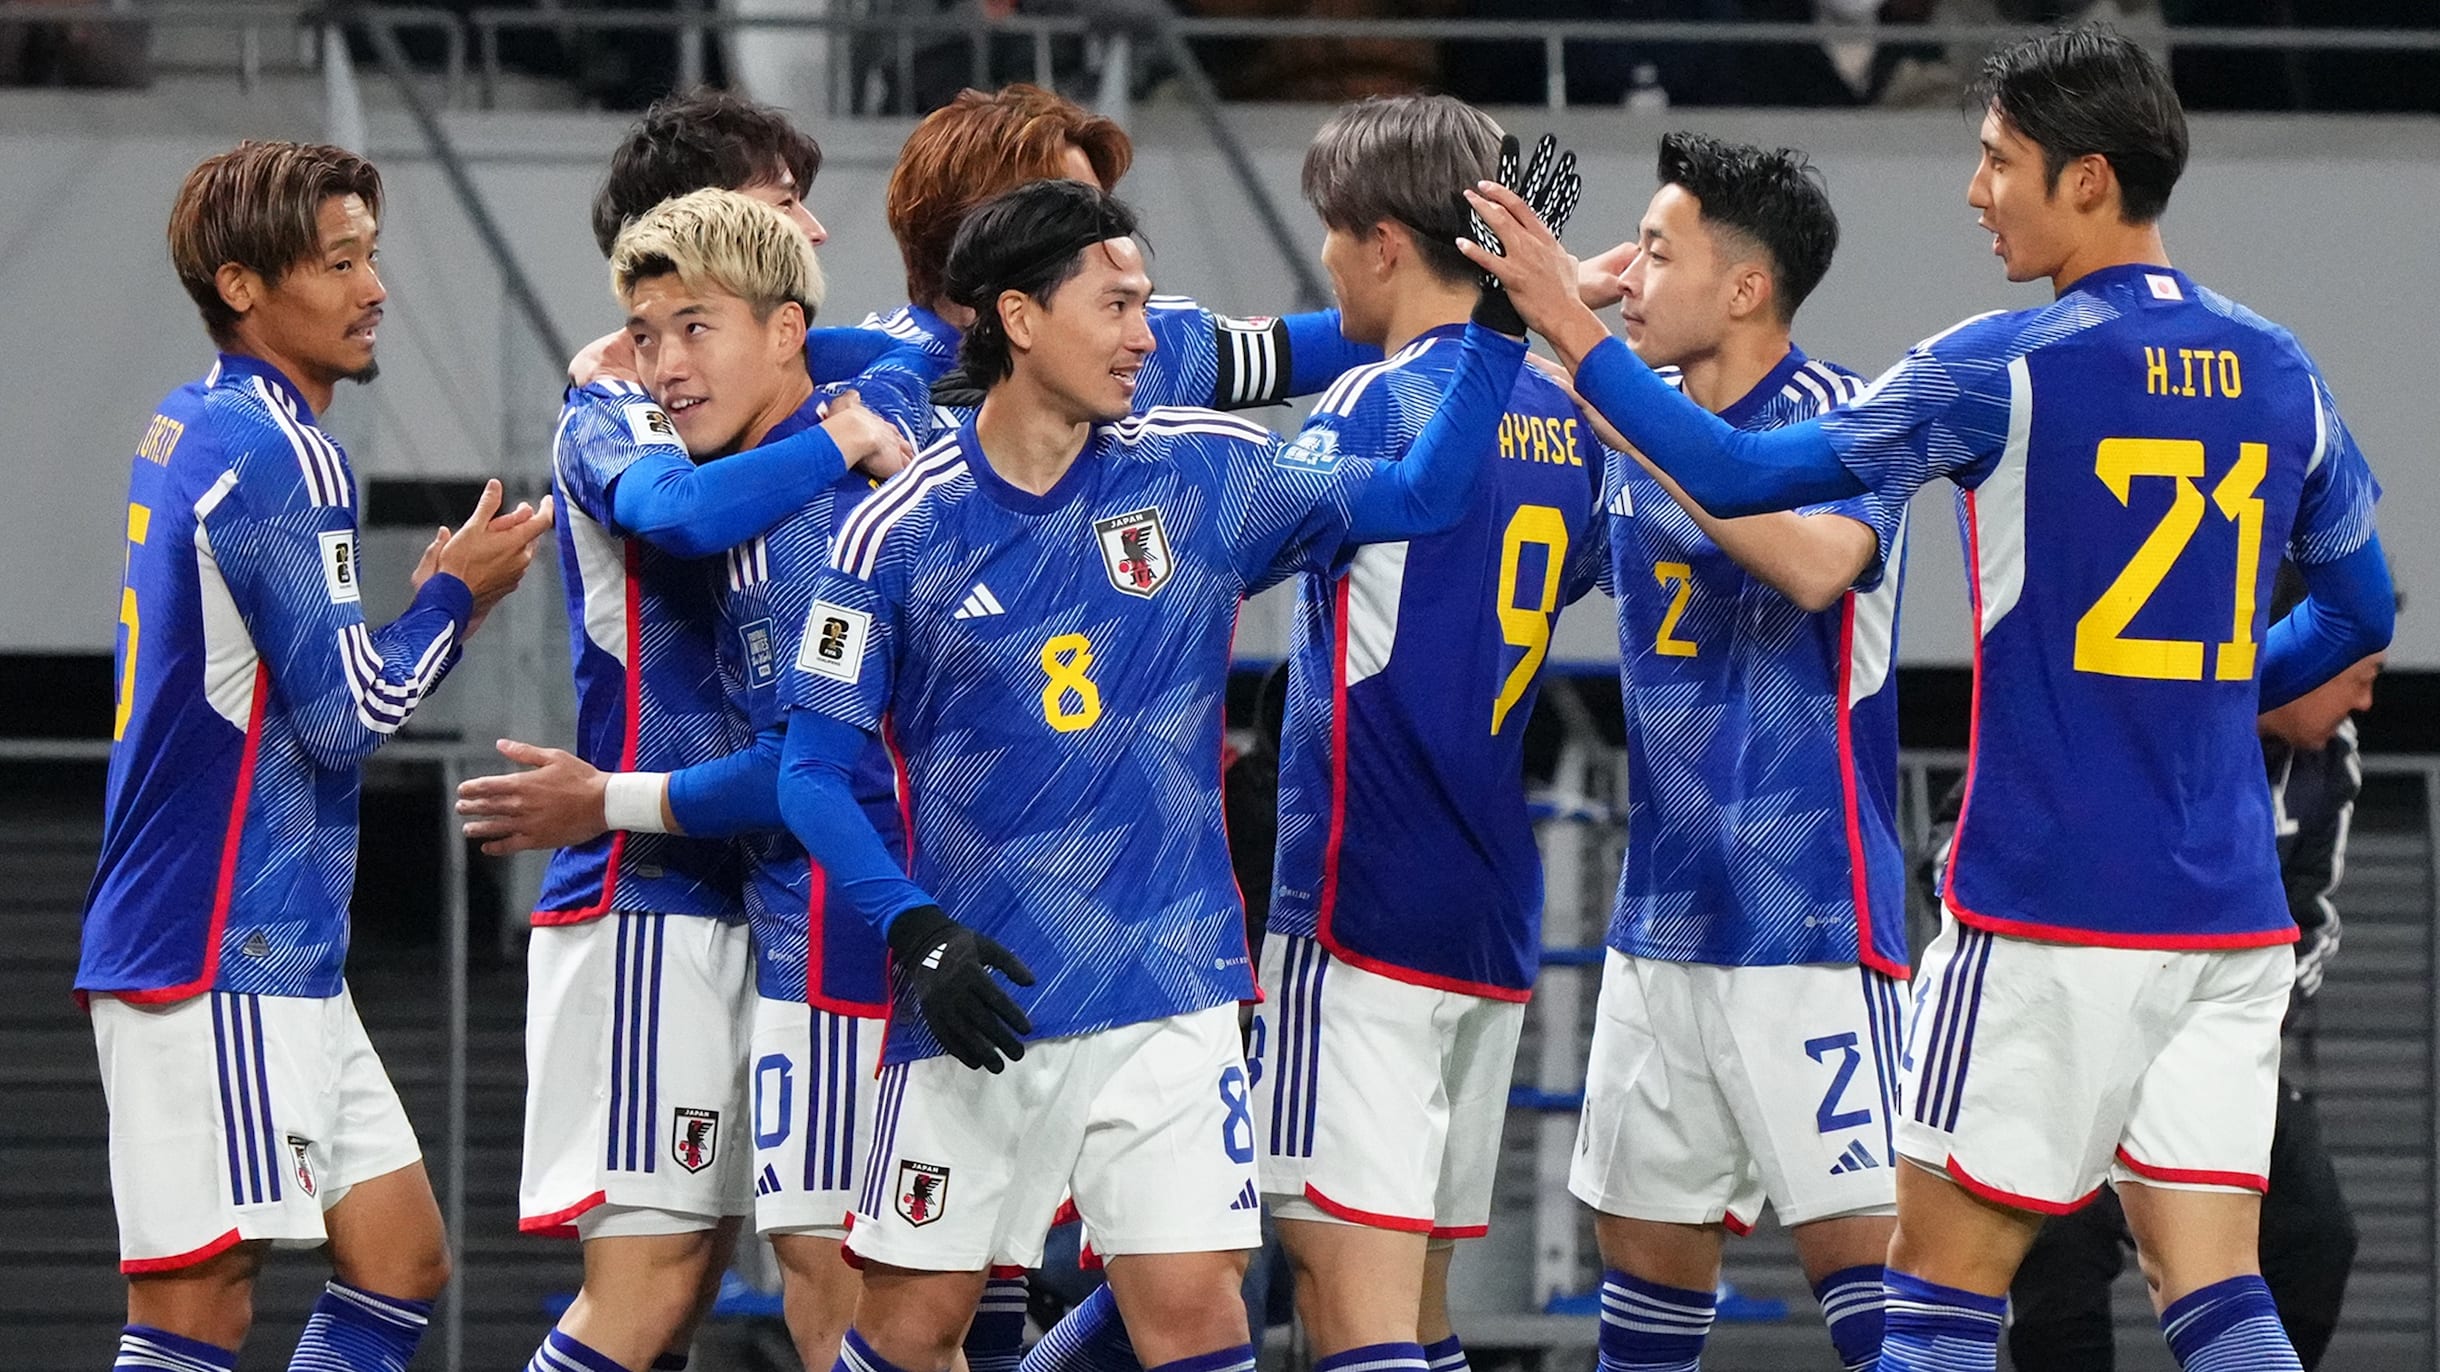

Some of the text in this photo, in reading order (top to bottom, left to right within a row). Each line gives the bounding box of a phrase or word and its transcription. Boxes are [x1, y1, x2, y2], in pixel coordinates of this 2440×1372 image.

[2143, 346, 2242, 399] H.ITO
[135, 413, 185, 468] ORITA
[1497, 411, 1583, 468] AYASE
[1110, 513, 1144, 530] JAPAN
[2073, 437, 2268, 681] 21
[1490, 504, 1569, 736] 9
[1654, 560, 1698, 657] 2
[1041, 632, 1103, 733] 8
[684, 1108, 710, 1118] JAPAN
[1219, 1066, 1254, 1165] 8
[1804, 1031, 1872, 1134] 2
[911, 1162, 939, 1174] JAPAN
